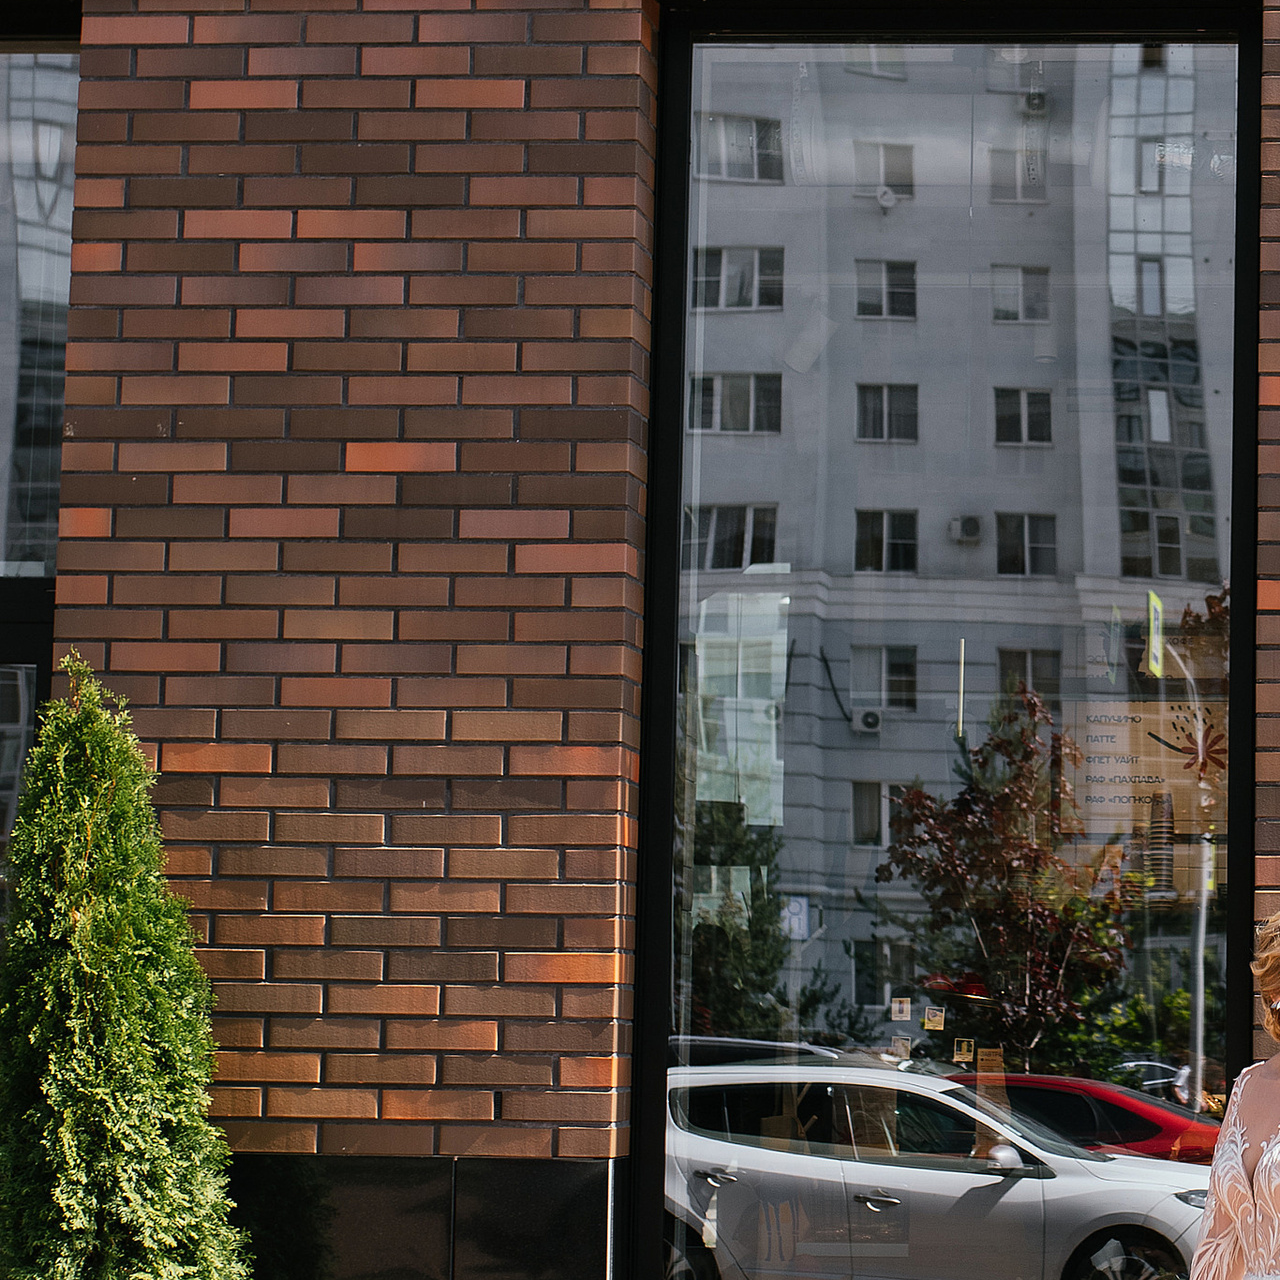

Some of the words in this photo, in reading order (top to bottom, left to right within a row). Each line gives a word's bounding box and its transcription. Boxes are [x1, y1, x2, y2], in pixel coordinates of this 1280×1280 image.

[1085, 714, 1142, 723] КАПУЧИНО
[1085, 775, 1106, 784] РАФ
[1085, 795, 1106, 804] РАФ
